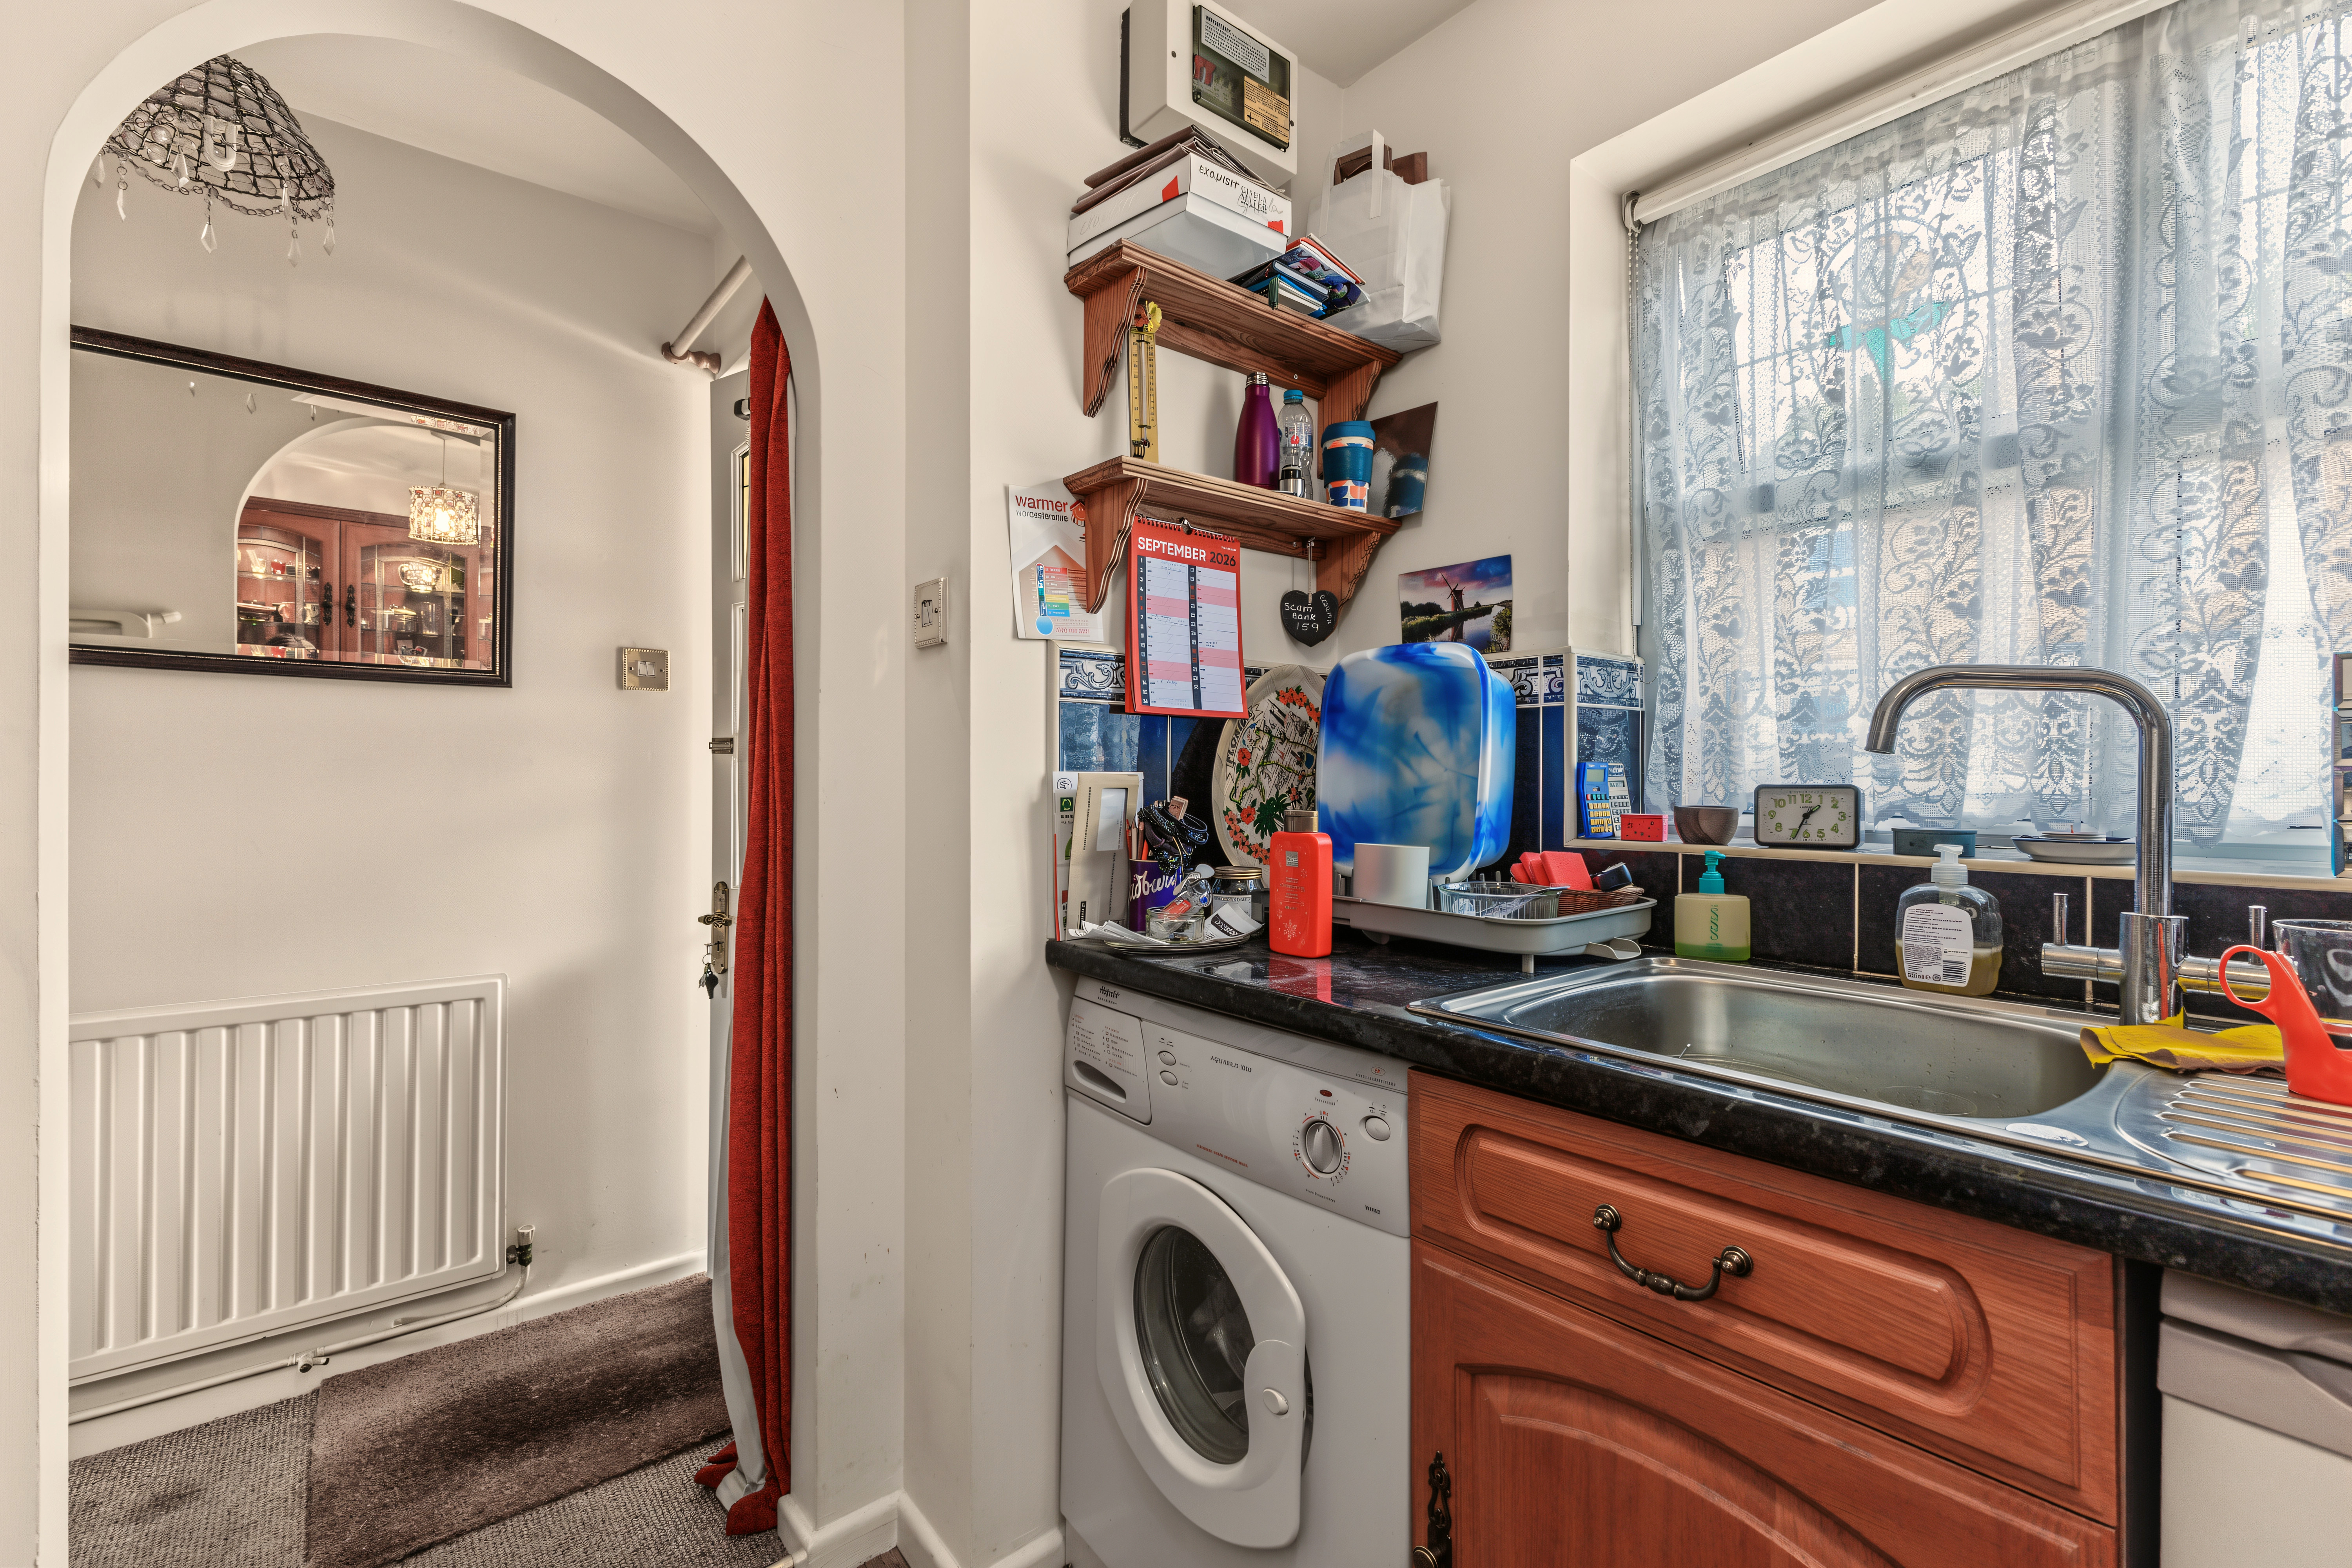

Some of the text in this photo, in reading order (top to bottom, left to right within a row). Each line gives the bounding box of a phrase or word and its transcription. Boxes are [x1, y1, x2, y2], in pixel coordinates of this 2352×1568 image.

[1015, 495, 1068, 513] warmer
[1138, 537, 1236, 567] SEPTEMBER 2026
[1297, 622, 1319, 632] 159
[1773, 798, 1786, 808] 10
[1787, 794, 1797, 804] 11
[1800, 793, 1812, 804] 12
[1818, 794, 1823, 804] 1
[1831, 797, 1839, 809] 2
[1768, 810, 1776, 819] 9
[1838, 811, 1846, 821] 3
[1775, 822, 1783, 832] 8
[1830, 823, 1839, 833] 4
[1788, 828, 1799, 839] 7
[1802, 829, 1810, 838] 6
[1817, 828, 1825, 838] 5
